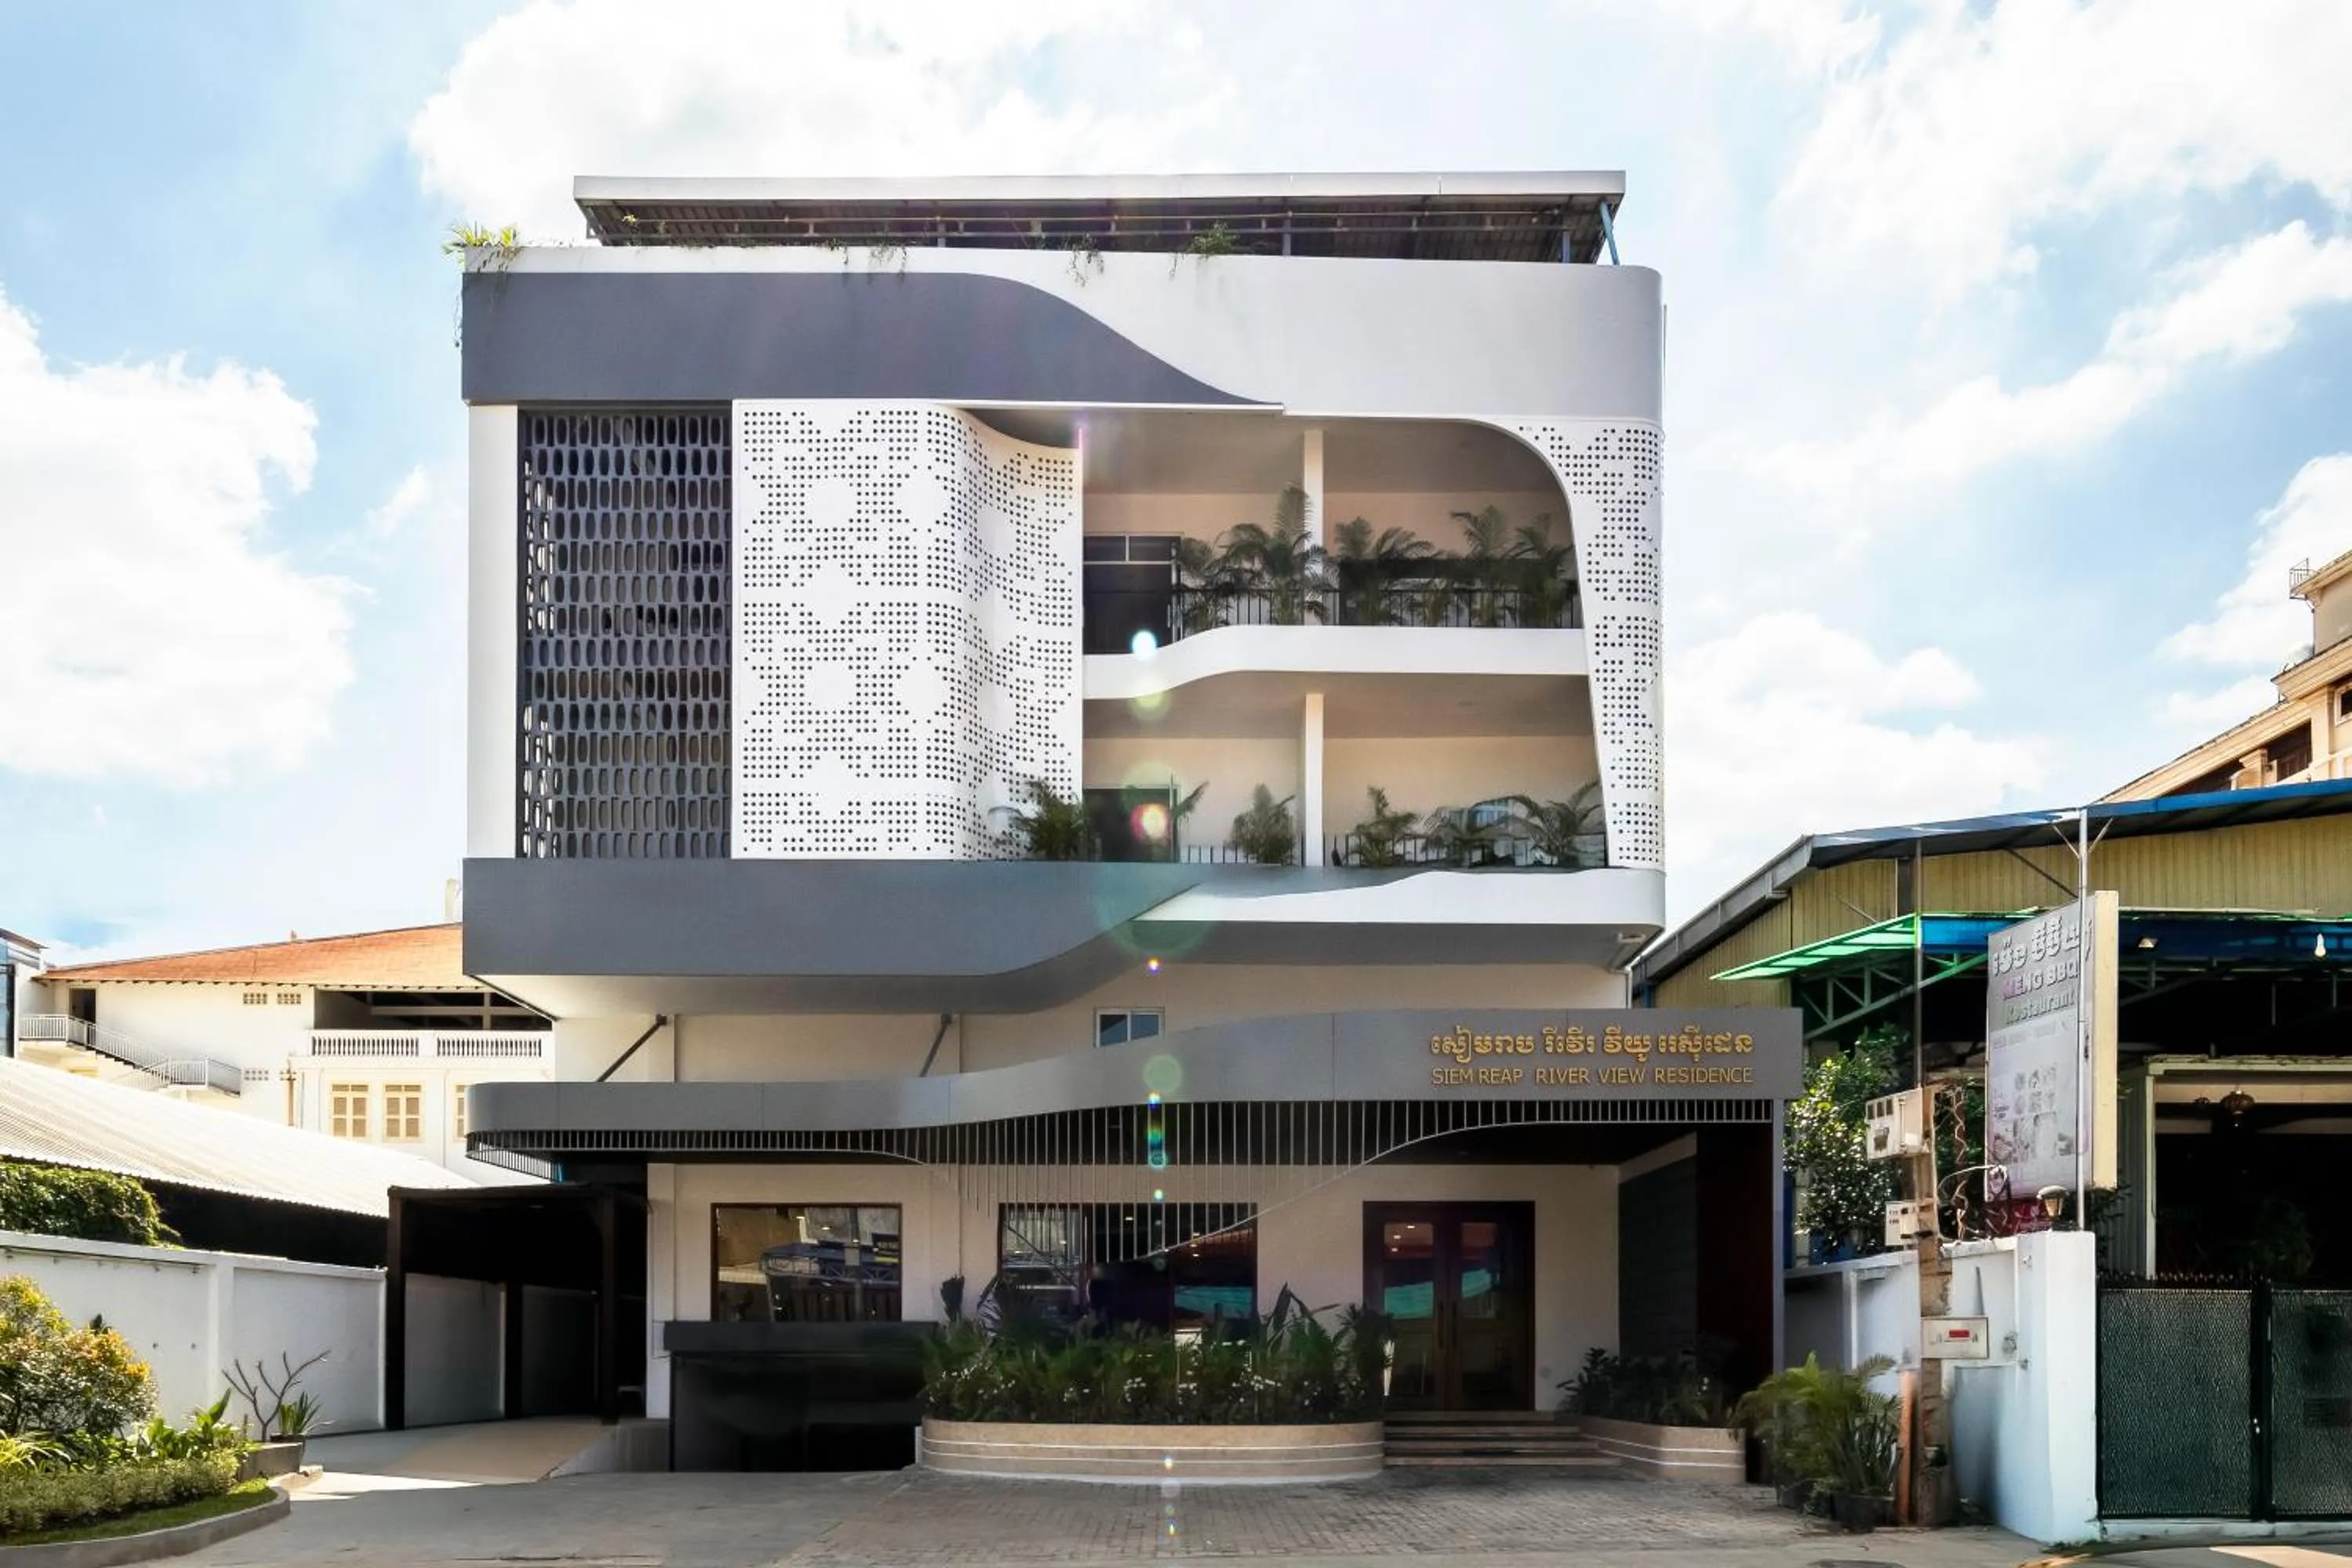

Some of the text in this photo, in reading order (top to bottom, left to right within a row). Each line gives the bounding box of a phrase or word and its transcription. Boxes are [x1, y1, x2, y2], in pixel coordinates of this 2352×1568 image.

[2002, 959, 2080, 1001] MENG BBQ
[1432, 1067, 1753, 1085] SIEM REAP RIVER VIEW RESIDENCE
